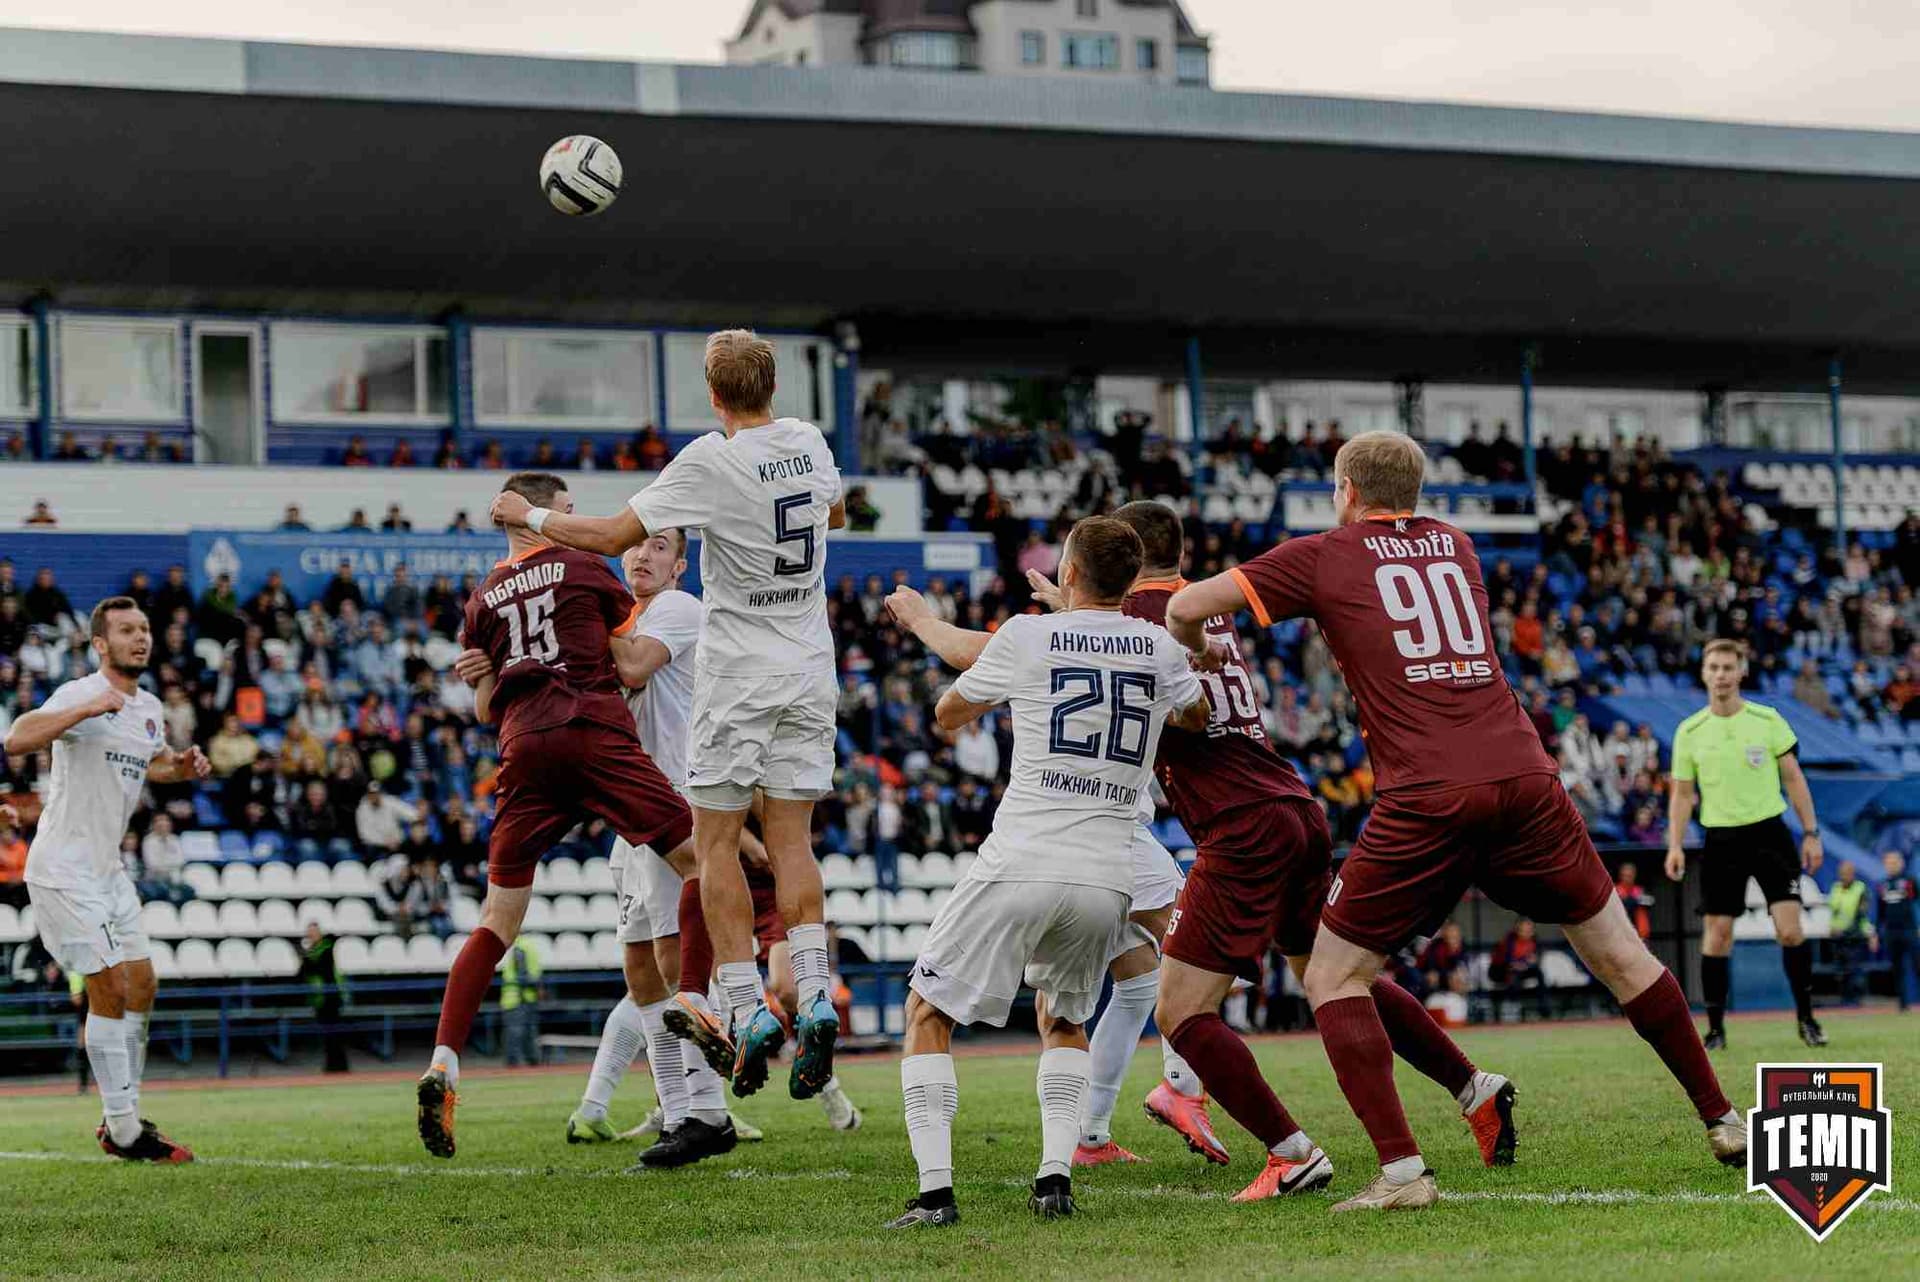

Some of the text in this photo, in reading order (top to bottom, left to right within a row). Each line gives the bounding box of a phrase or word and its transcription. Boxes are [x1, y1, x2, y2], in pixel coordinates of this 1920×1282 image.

[758, 454, 813, 483] КРОТОВ
[774, 491, 814, 576] 5
[1363, 530, 1456, 560] ЧЕВЕЛЁВ
[483, 562, 565, 609] АБРАМОВ
[749, 586, 799, 607] НИЖНИЙ
[1375, 561, 1486, 659] 90
[497, 589, 559, 662] 15
[1050, 631, 1154, 656] АНИСИМОВ
[1404, 660, 1493, 683] SEUS
[1049, 667, 1156, 768] 26
[1040, 769, 1101, 798] НИЖНИЙ
